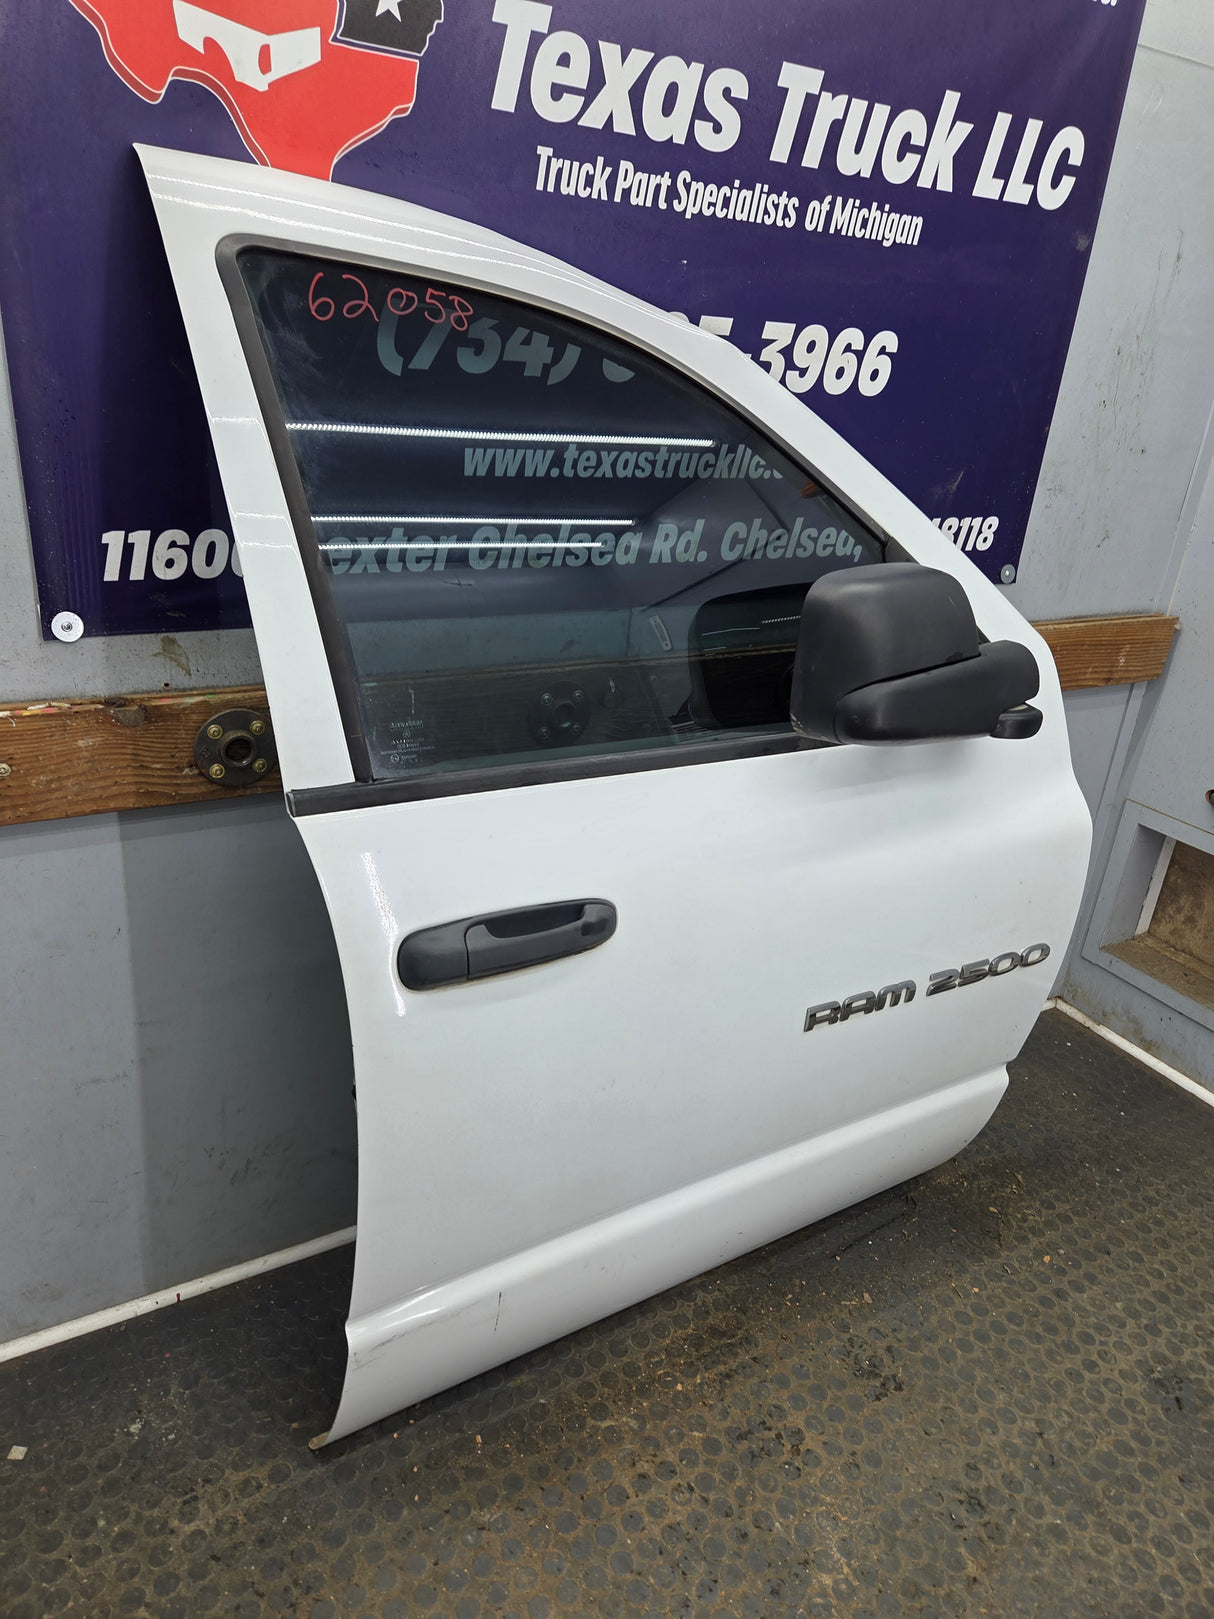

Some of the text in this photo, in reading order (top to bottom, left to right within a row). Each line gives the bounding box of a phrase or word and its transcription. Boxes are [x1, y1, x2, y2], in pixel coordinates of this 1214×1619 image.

[491, 0, 1085, 211] Texas Truck LLC
[536, 145, 924, 248] Truck Part Specialists of Michigan
[308, 271, 474, 331] 62058
[101, 516, 1000, 582] 1160 exter Chelsea Rd. Chelsea, 8118
[803, 942, 1051, 1033] RAM 2500
